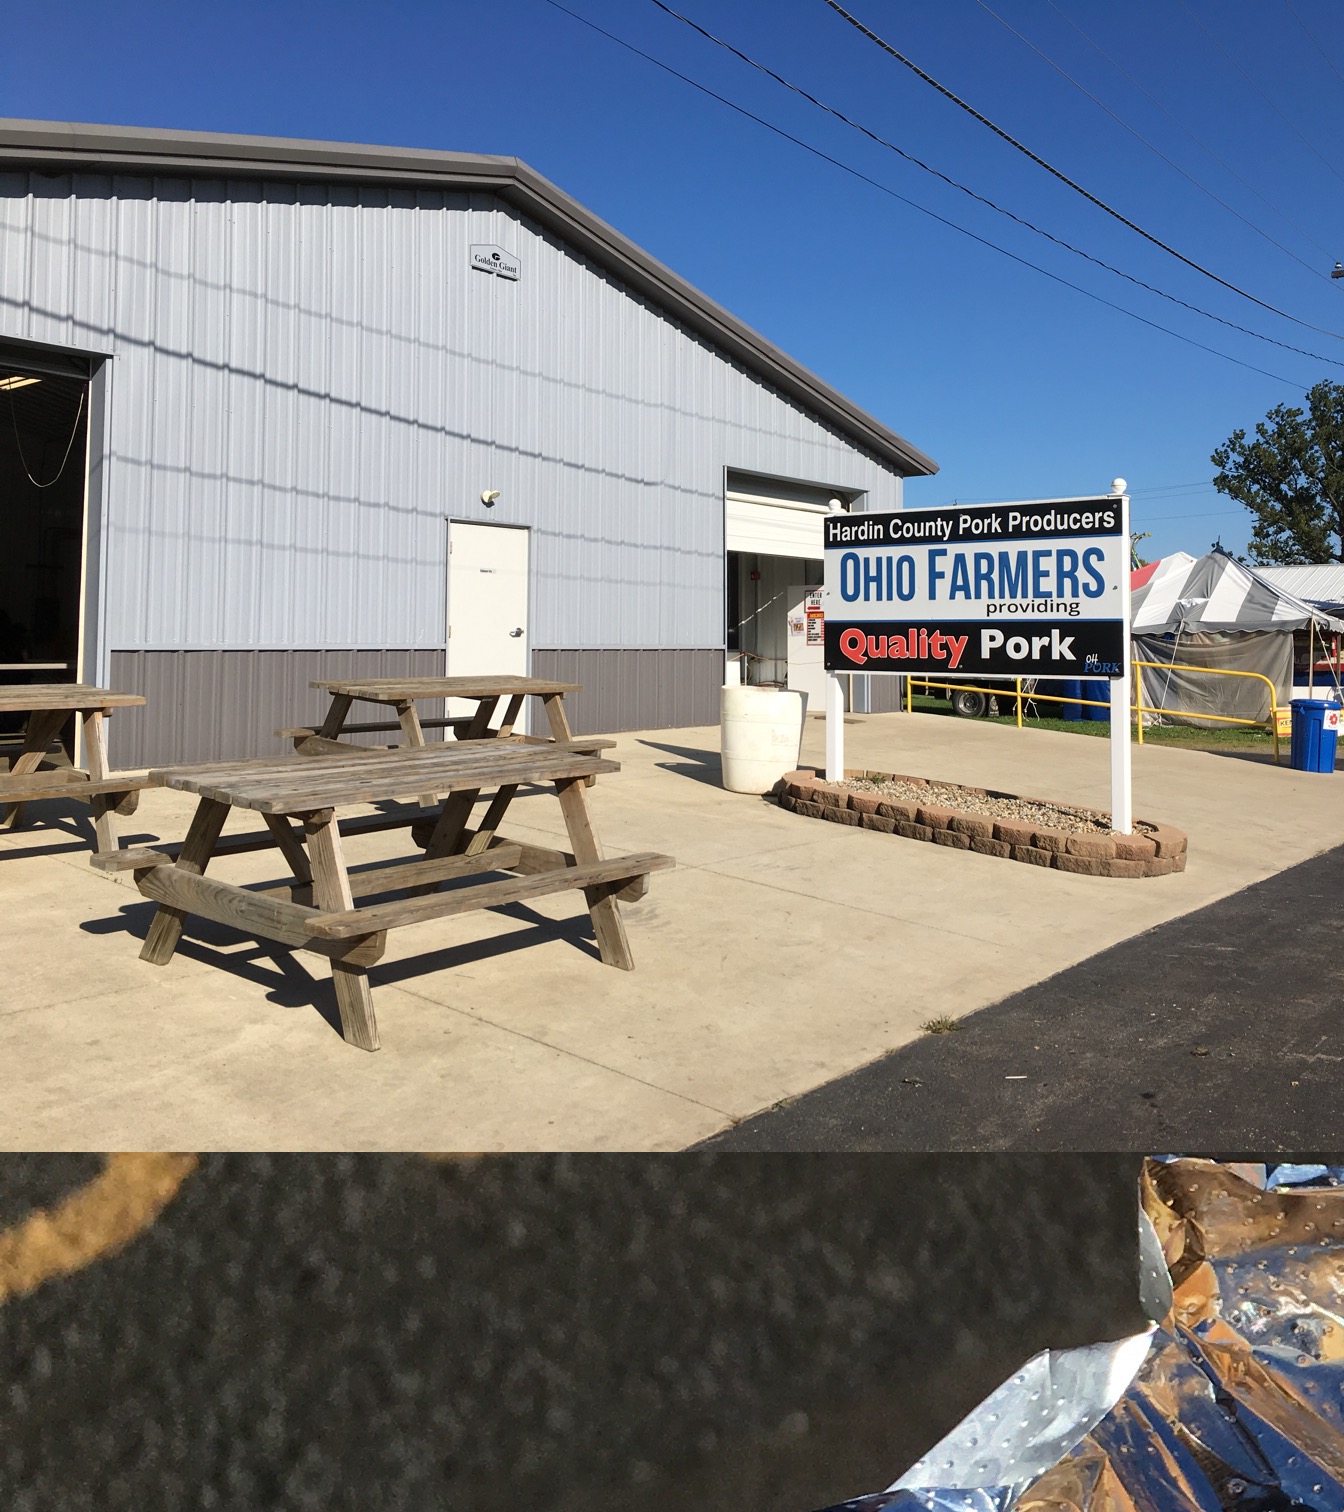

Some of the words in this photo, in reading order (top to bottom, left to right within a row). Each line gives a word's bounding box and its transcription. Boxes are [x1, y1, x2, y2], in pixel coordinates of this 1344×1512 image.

[475, 254, 497, 268] Golden
[499, 262, 516, 273] Giant
[829, 521, 884, 541] Hardin
[889, 518, 953, 541] County
[959, 513, 1002, 534] Pork
[1008, 510, 1115, 532] Producers
[840, 552, 916, 602] OHIO
[928, 547, 1105, 600] FARMERS
[986, 600, 1080, 617] providing
[839, 628, 968, 669] Quality
[980, 628, 1077, 660] Pork
[1083, 662, 1121, 673] PORK
